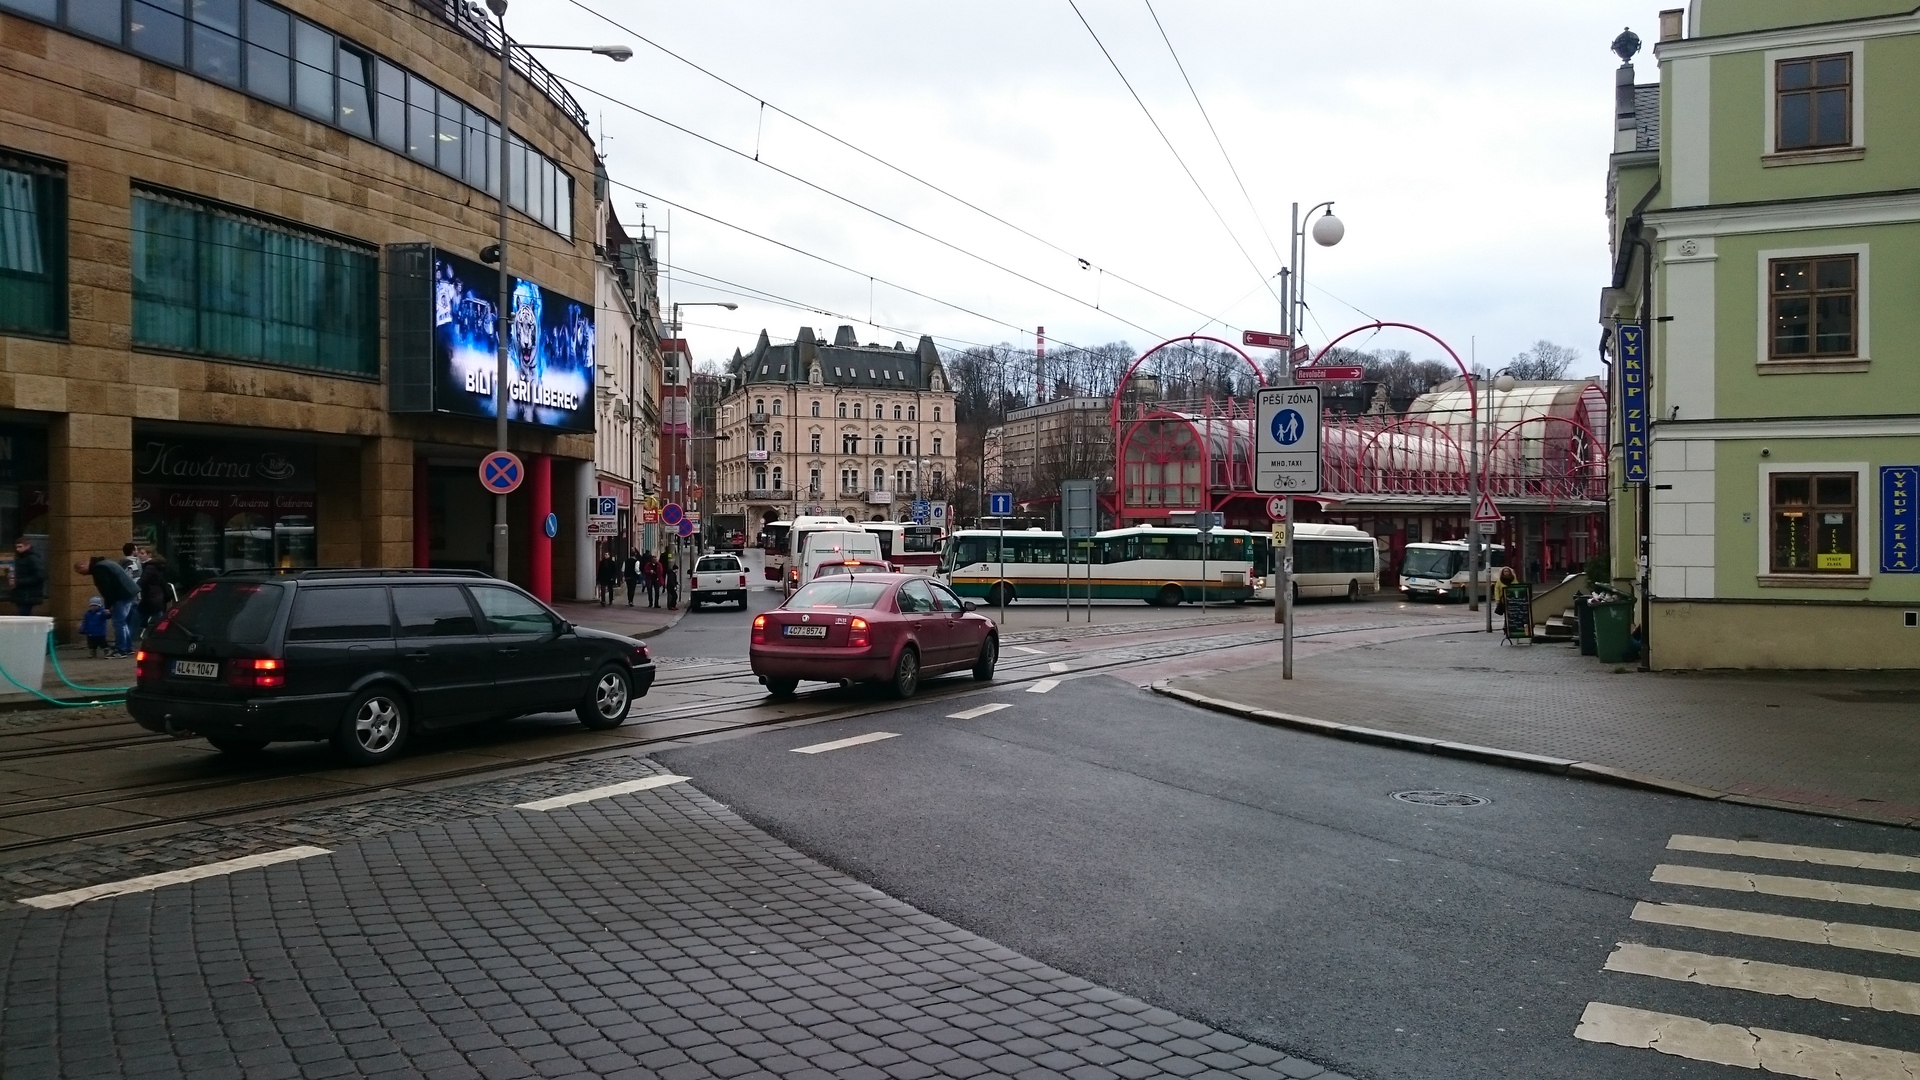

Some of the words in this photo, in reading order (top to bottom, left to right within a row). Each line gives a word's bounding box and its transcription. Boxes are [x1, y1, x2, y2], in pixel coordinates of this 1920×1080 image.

[1624, 332, 1641, 396] VÝKUP
[1298, 369, 1326, 378] Revoluční
[534, 383, 578, 410] LIBEREC
[1263, 394, 1284, 405] PĚŠÍ
[1287, 393, 1313, 404] ZÓNA
[1628, 409, 1643, 474] ZLATA
[137, 442, 251, 478] Kavárna
[1894, 472, 1907, 515] VÝKUP
[169, 493, 219, 508] Cukrárna
[228, 495, 269, 508] Kavárna
[275, 495, 313, 508] Cukrárna
[605, 503, 611, 511] P
[1275, 531, 1284, 540] 20
[1893, 524, 1907, 567] ZLATA
[805, 627, 823, 635] 8574
[177, 662, 190, 673] 4L4
[197, 664, 215, 675] 1047
